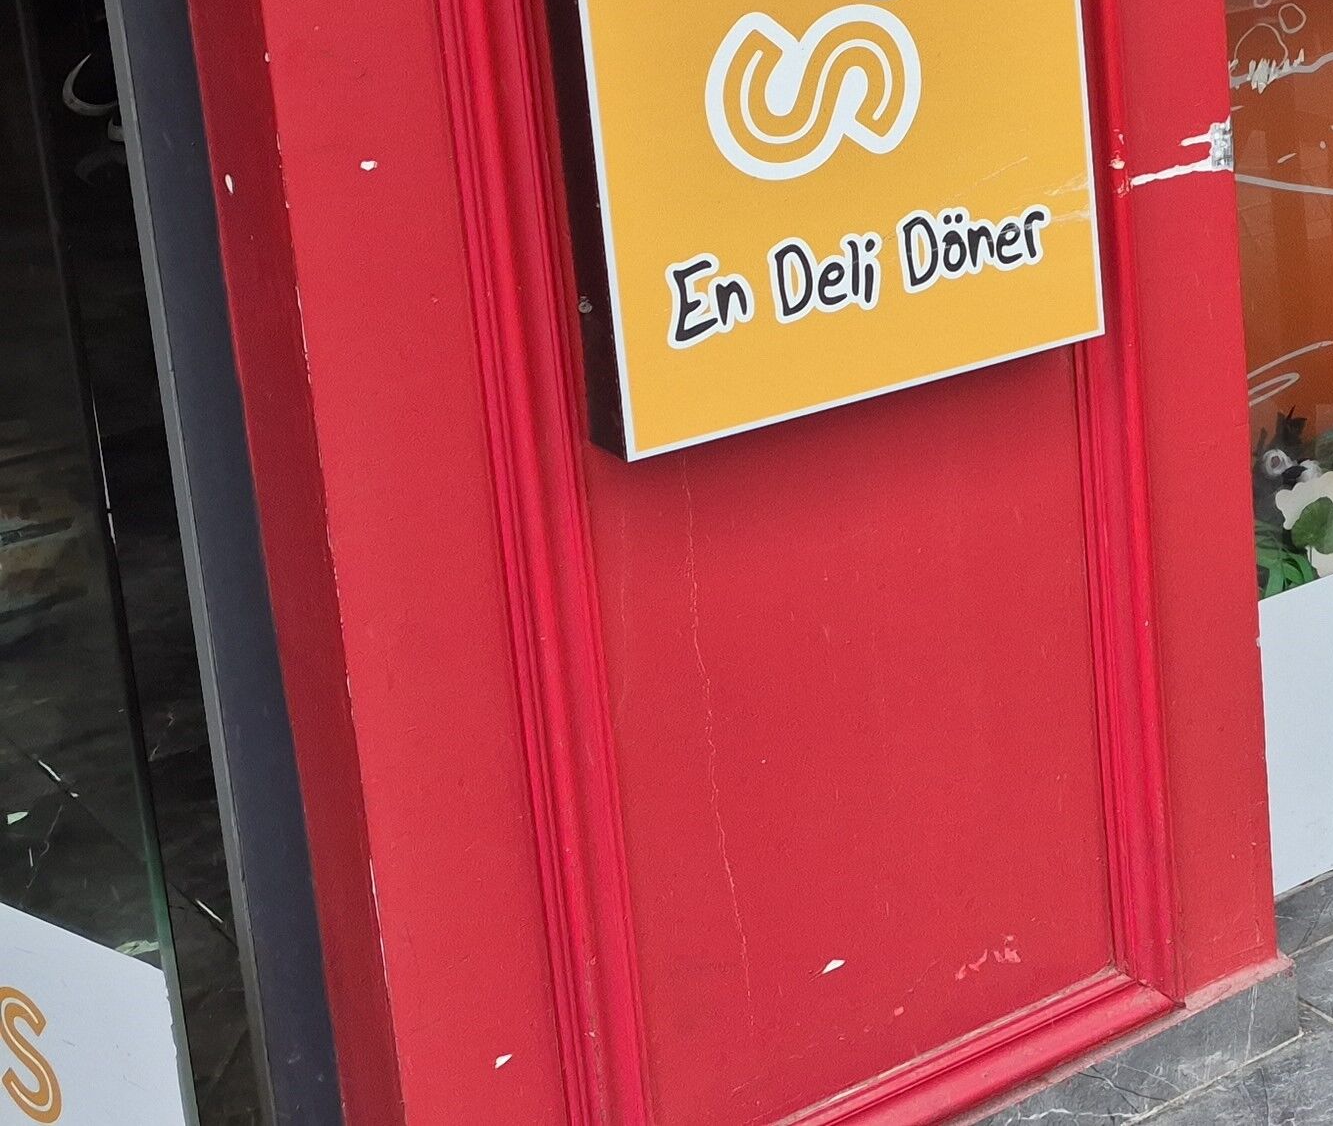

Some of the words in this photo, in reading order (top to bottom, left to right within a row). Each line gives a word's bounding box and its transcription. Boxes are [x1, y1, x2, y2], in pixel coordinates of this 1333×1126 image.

[673, 260, 748, 342] En
[774, 238, 882, 317] Deli
[902, 210, 1046, 288] Döner
